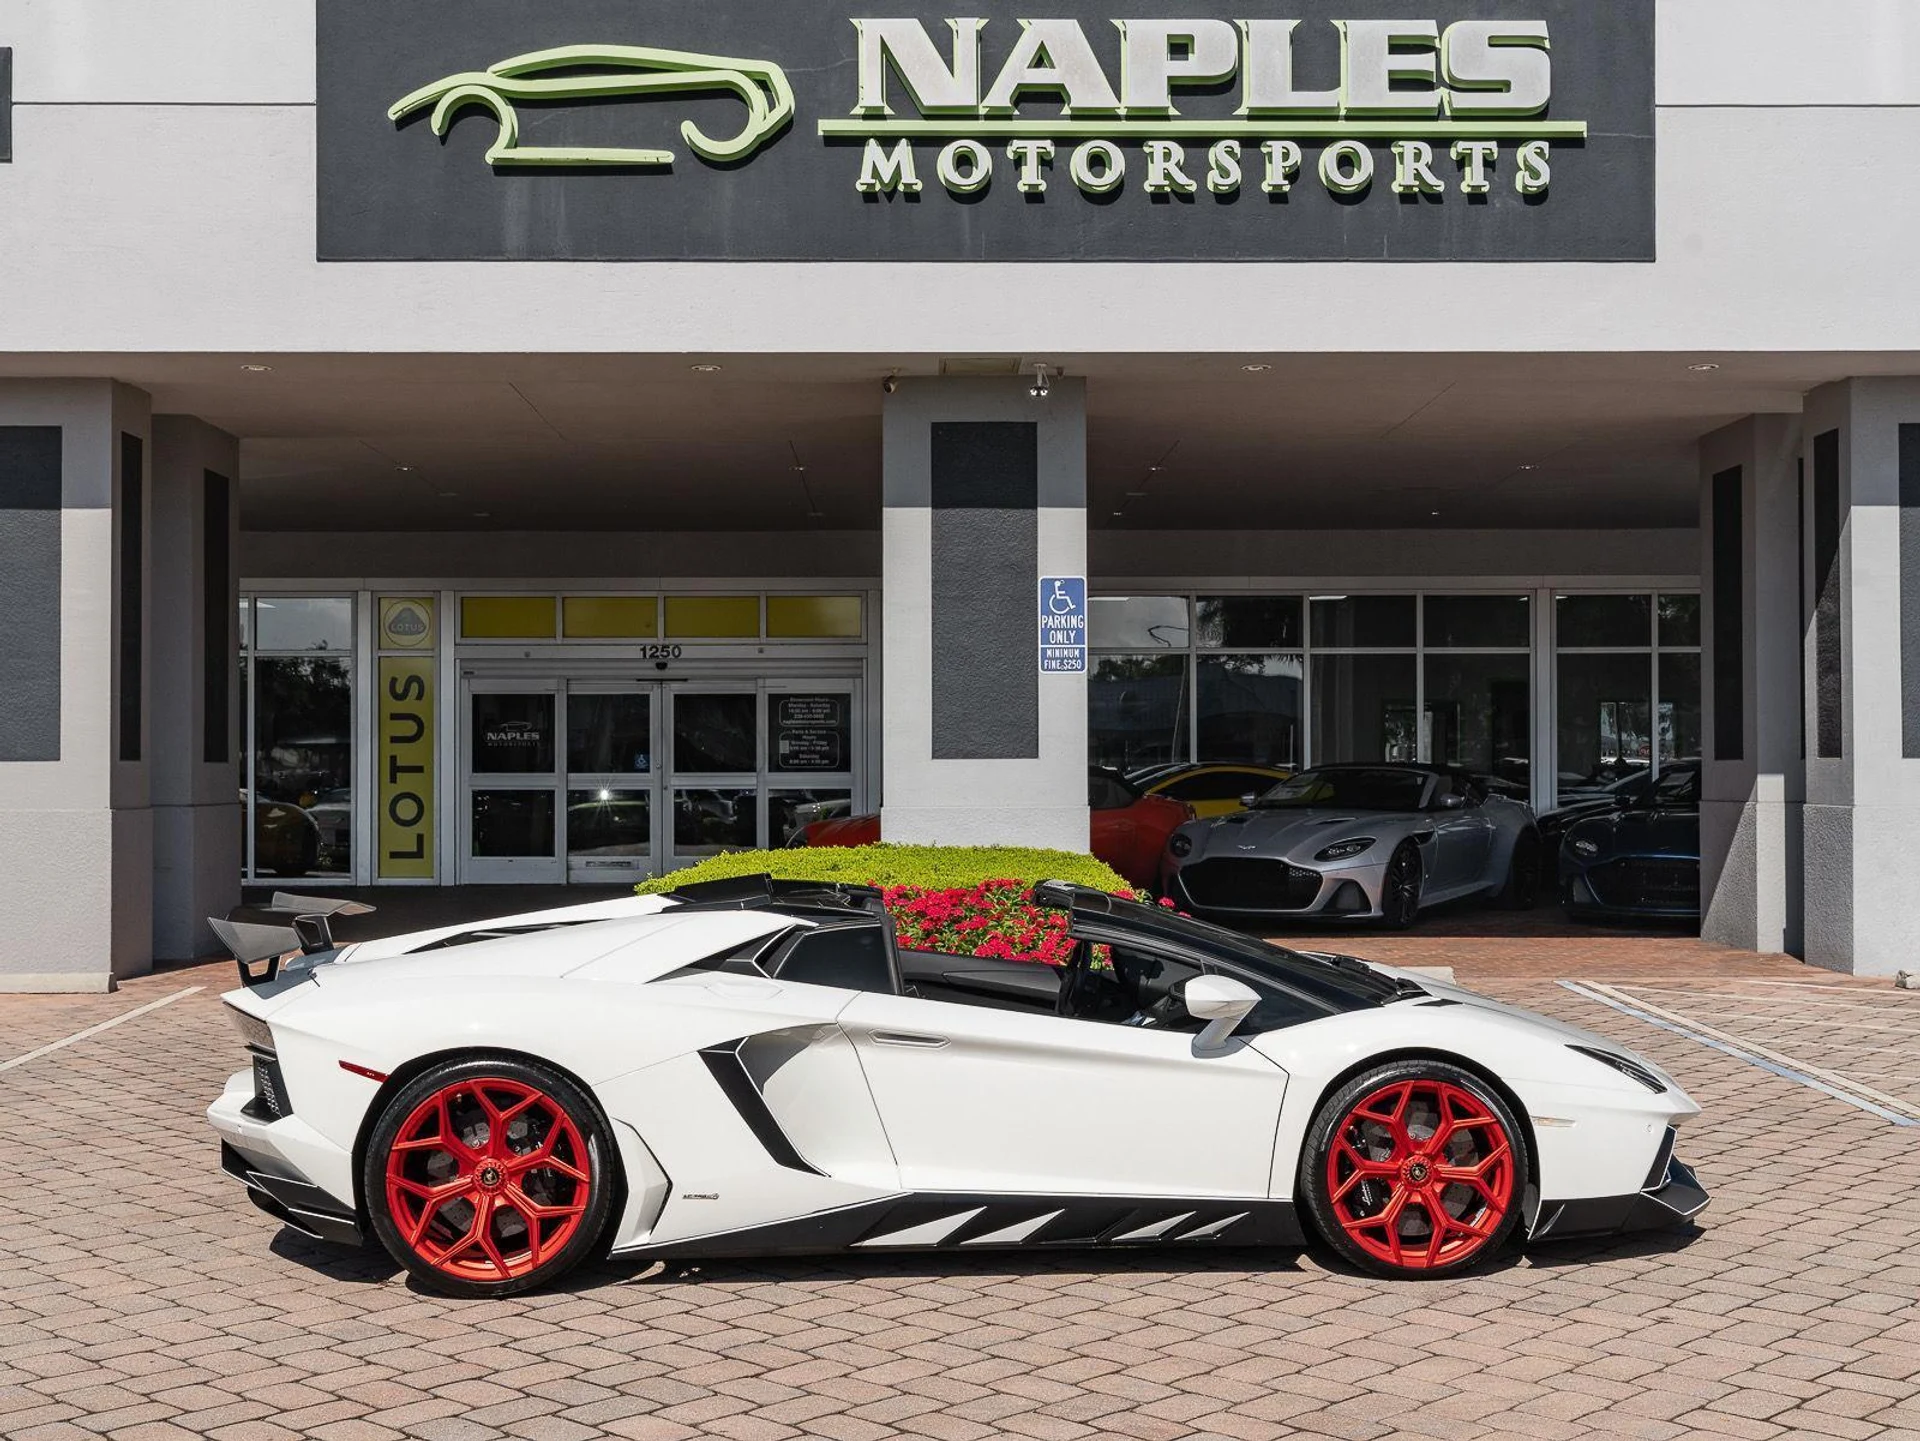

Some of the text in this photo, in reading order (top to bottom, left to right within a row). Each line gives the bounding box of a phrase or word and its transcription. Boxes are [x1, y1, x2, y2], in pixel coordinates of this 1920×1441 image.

[849, 18, 1551, 118] NAPLES
[855, 138, 1551, 194] MOTORSPORTS
[390, 623, 424, 632] LOTUS
[1041, 615, 1084, 629] PARKING
[1049, 630, 1077, 644] ONLY
[640, 645, 682, 659] 1250
[1046, 648, 1080, 658] MINIMUM
[1044, 659, 1082, 671] FINE $250
[487, 732, 540, 741] NAPLES
[388, 674, 425, 860] LOTUS
